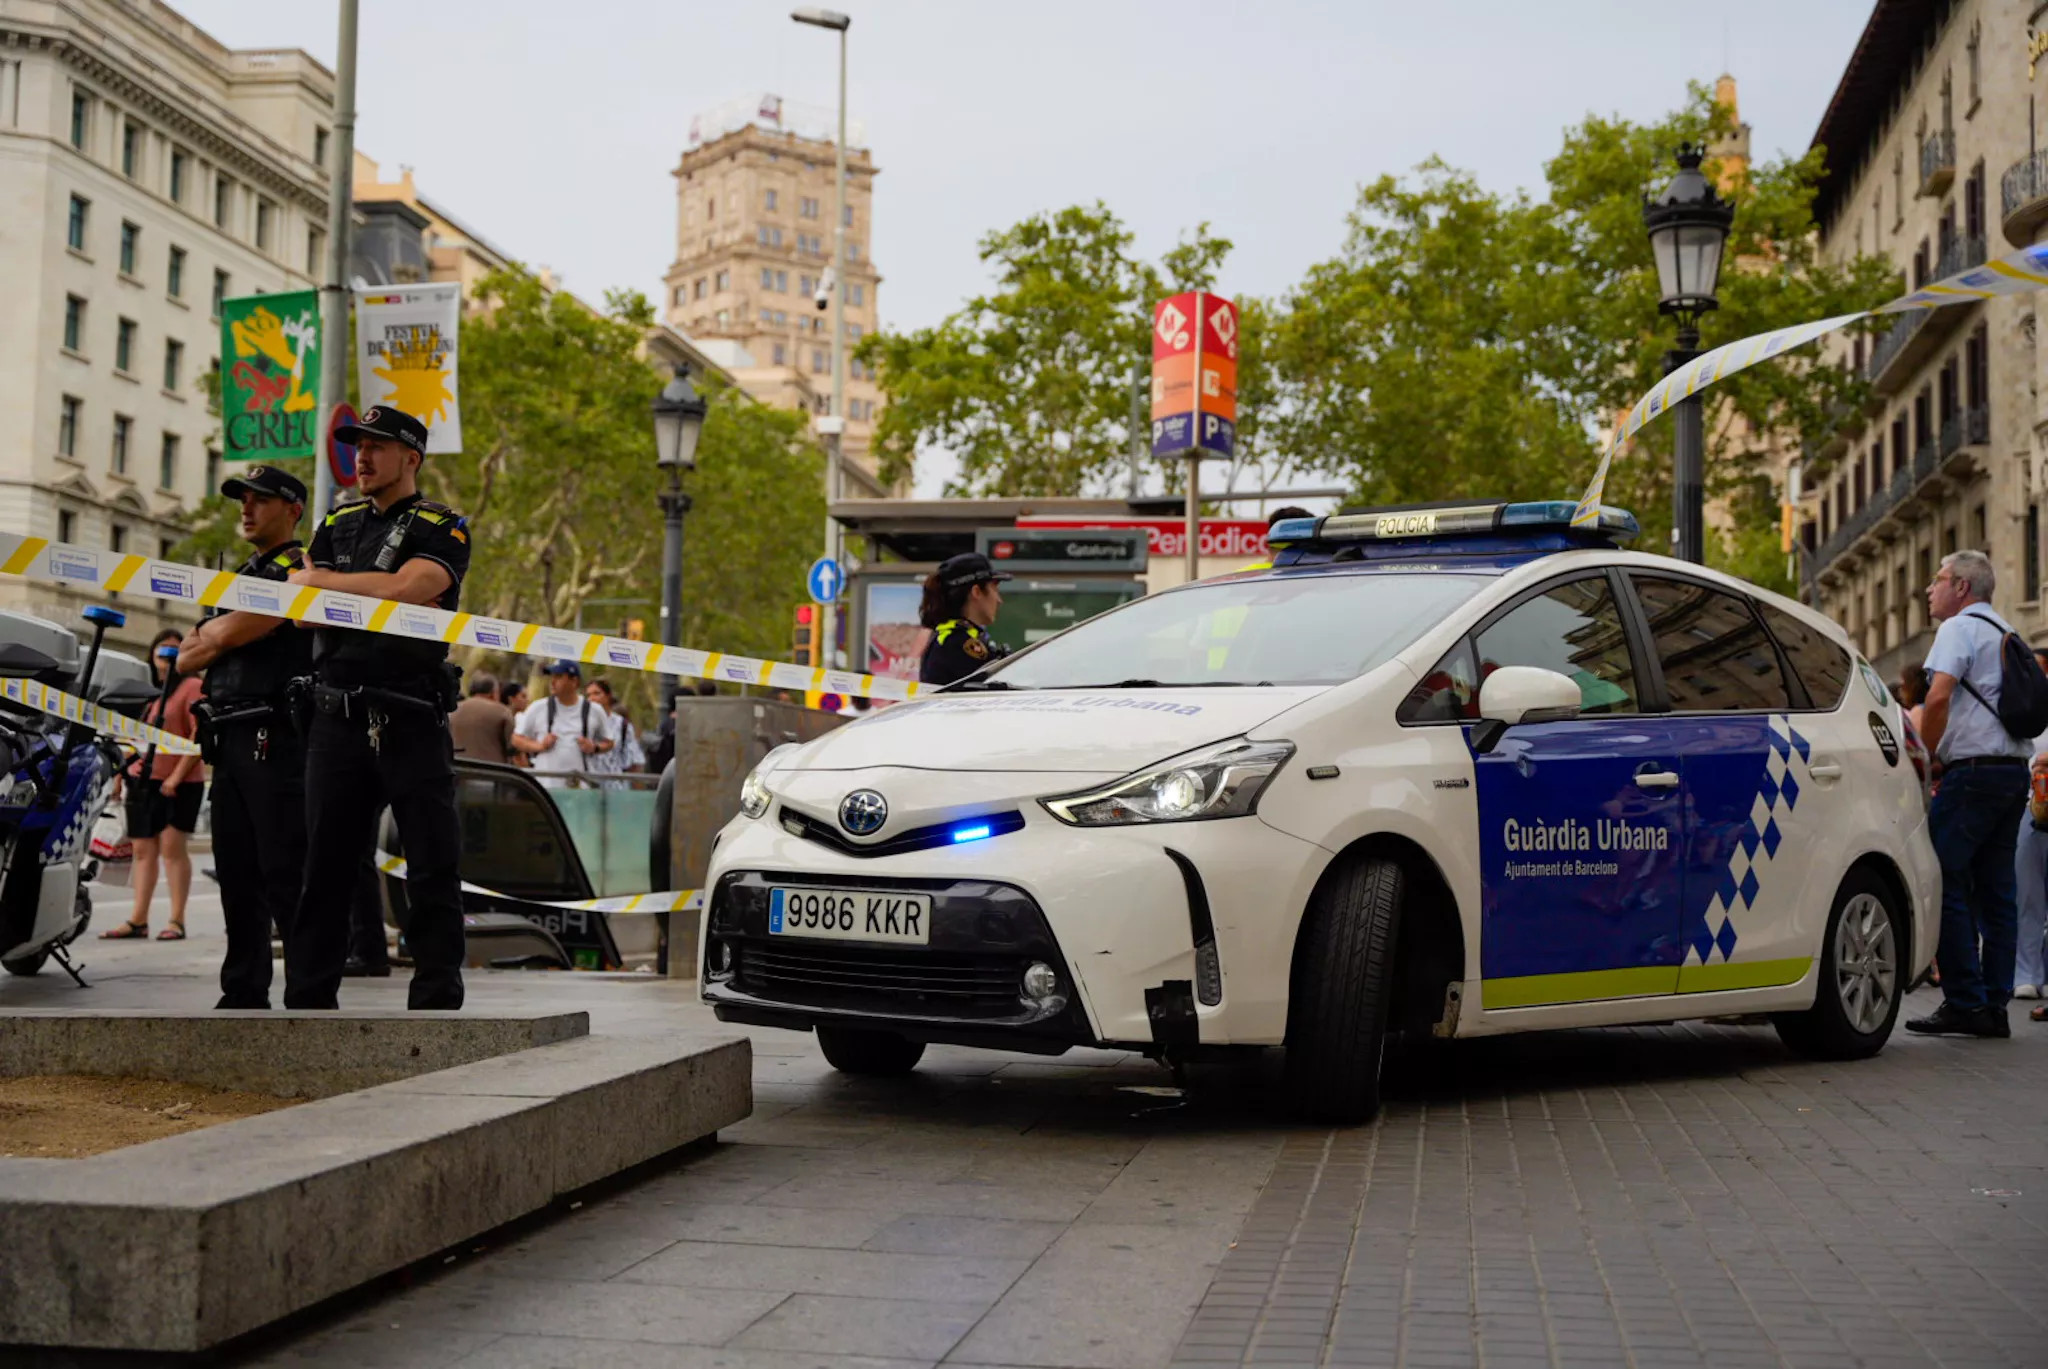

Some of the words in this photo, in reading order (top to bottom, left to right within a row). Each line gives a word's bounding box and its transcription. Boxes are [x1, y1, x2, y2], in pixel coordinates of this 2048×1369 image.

[1153, 421, 1163, 446] P
[1205, 415, 1219, 440] P
[1378, 515, 1429, 535] POLICIA
[1146, 524, 1270, 555] Peródico
[1072, 696, 1203, 716] Urbana
[1504, 817, 1590, 852] Guàrdia
[1597, 818, 1668, 851] Urbana
[1504, 861, 1561, 880] Ajuntament
[1562, 860, 1574, 876] de
[1575, 860, 1618, 876] Barcelona
[788, 894, 855, 931] 9986
[866, 899, 921, 936] KKR
